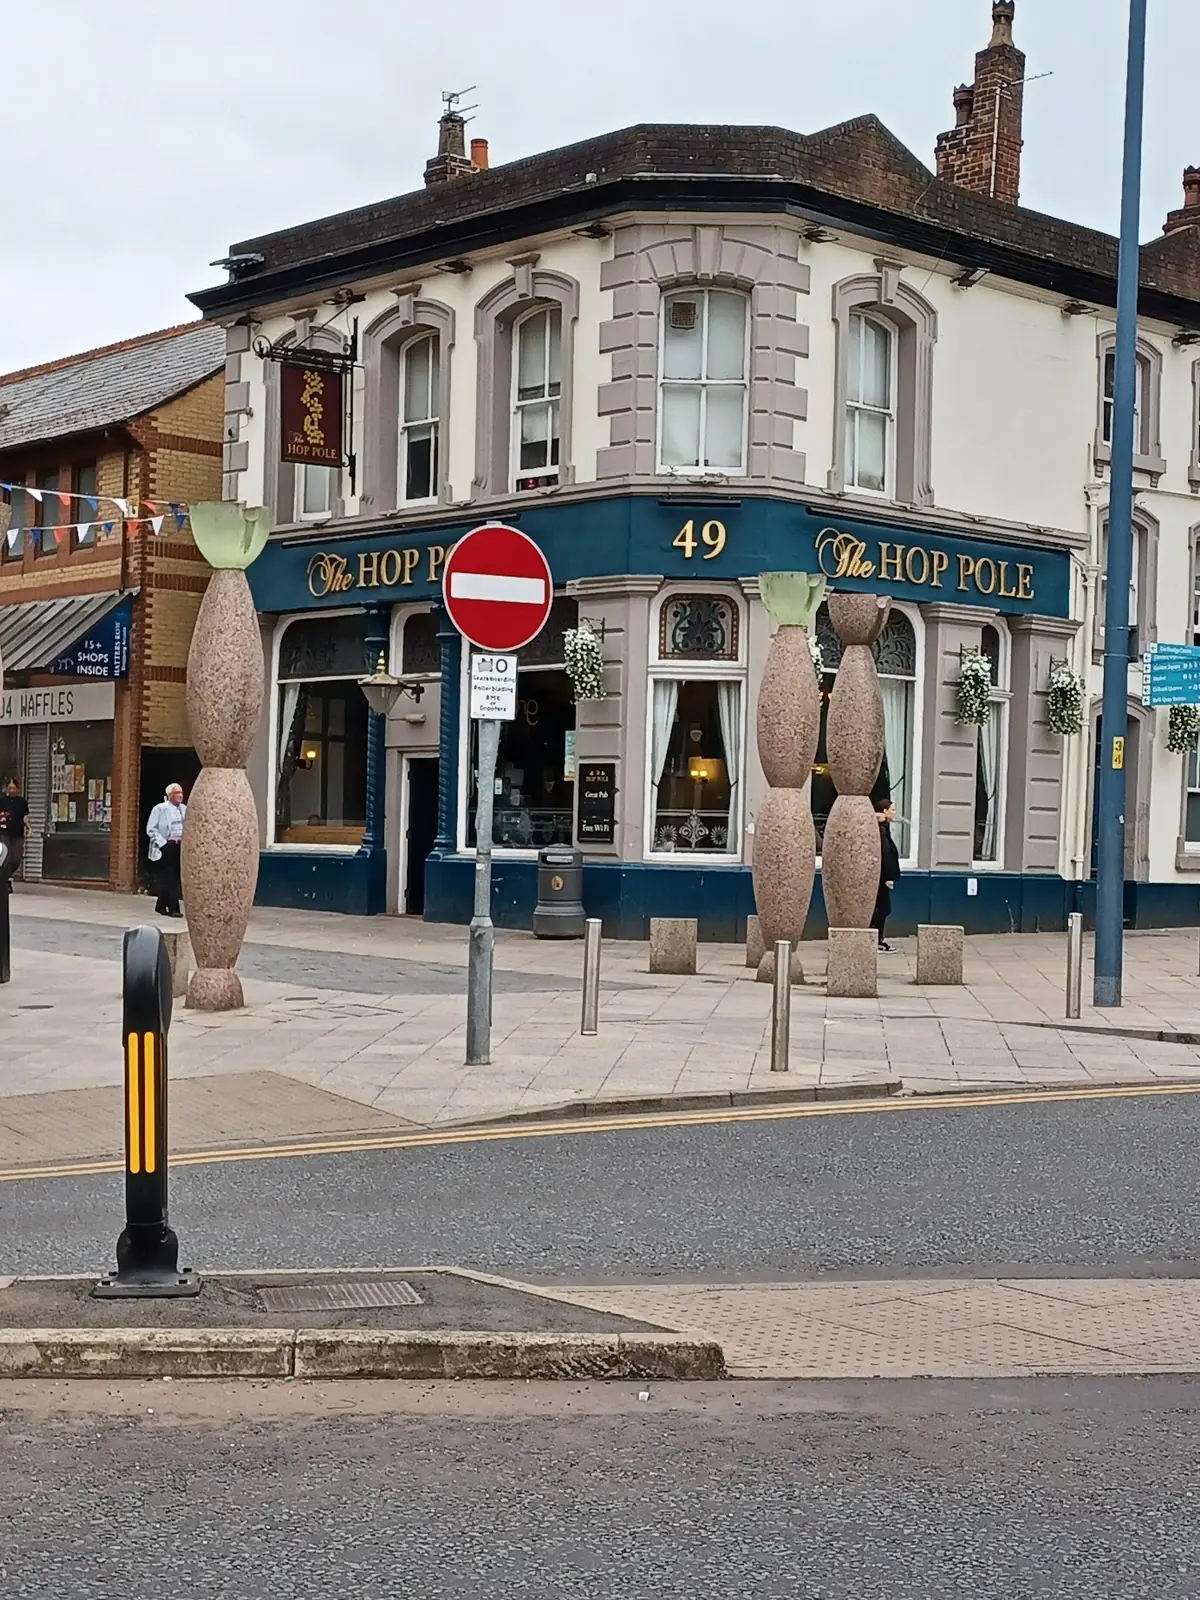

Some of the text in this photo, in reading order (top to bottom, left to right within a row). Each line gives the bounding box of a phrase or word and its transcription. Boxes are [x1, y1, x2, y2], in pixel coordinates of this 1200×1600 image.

[288, 444, 337, 459] HOP POLE
[672, 519, 727, 560] 49
[307, 552, 355, 596] The
[356, 548, 419, 587] HOP
[815, 527, 1035, 600] The HOP POLE
[84, 640, 102, 649] 15+
[77, 651, 109, 663] SHOPS
[77, 665, 108, 676] INSIDE
[20, 691, 74, 717] WAFFLES
